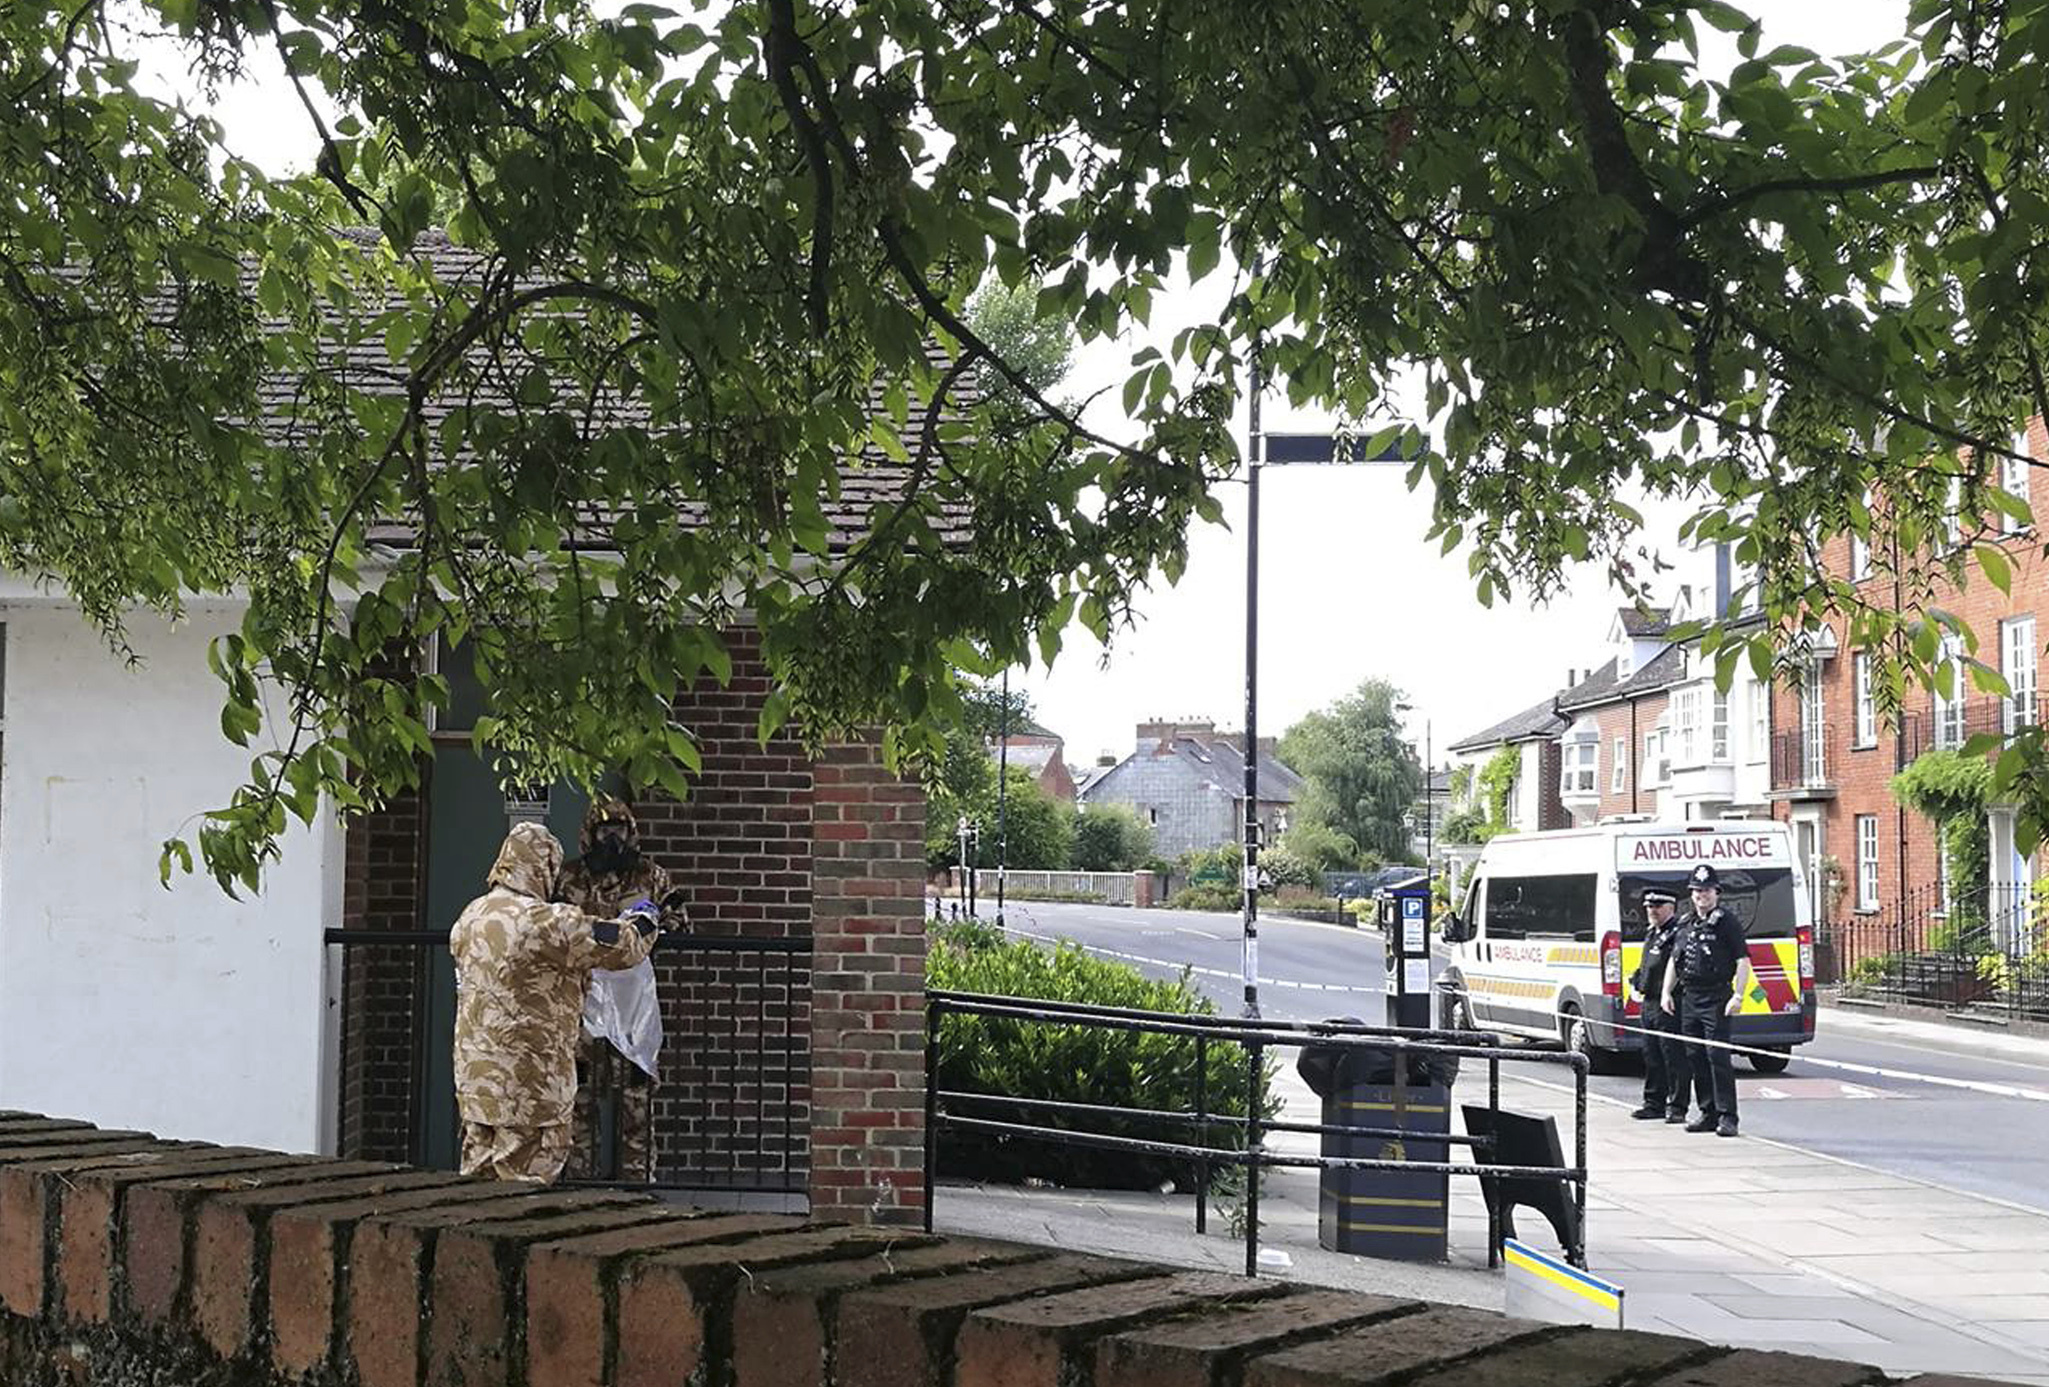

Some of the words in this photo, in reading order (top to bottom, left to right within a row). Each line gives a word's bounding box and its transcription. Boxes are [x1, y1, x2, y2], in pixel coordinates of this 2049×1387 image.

[1634, 837, 1773, 861] AMBULANCE
[1408, 902, 1419, 915] P
[1494, 945, 1543, 963] AMBULANCE
